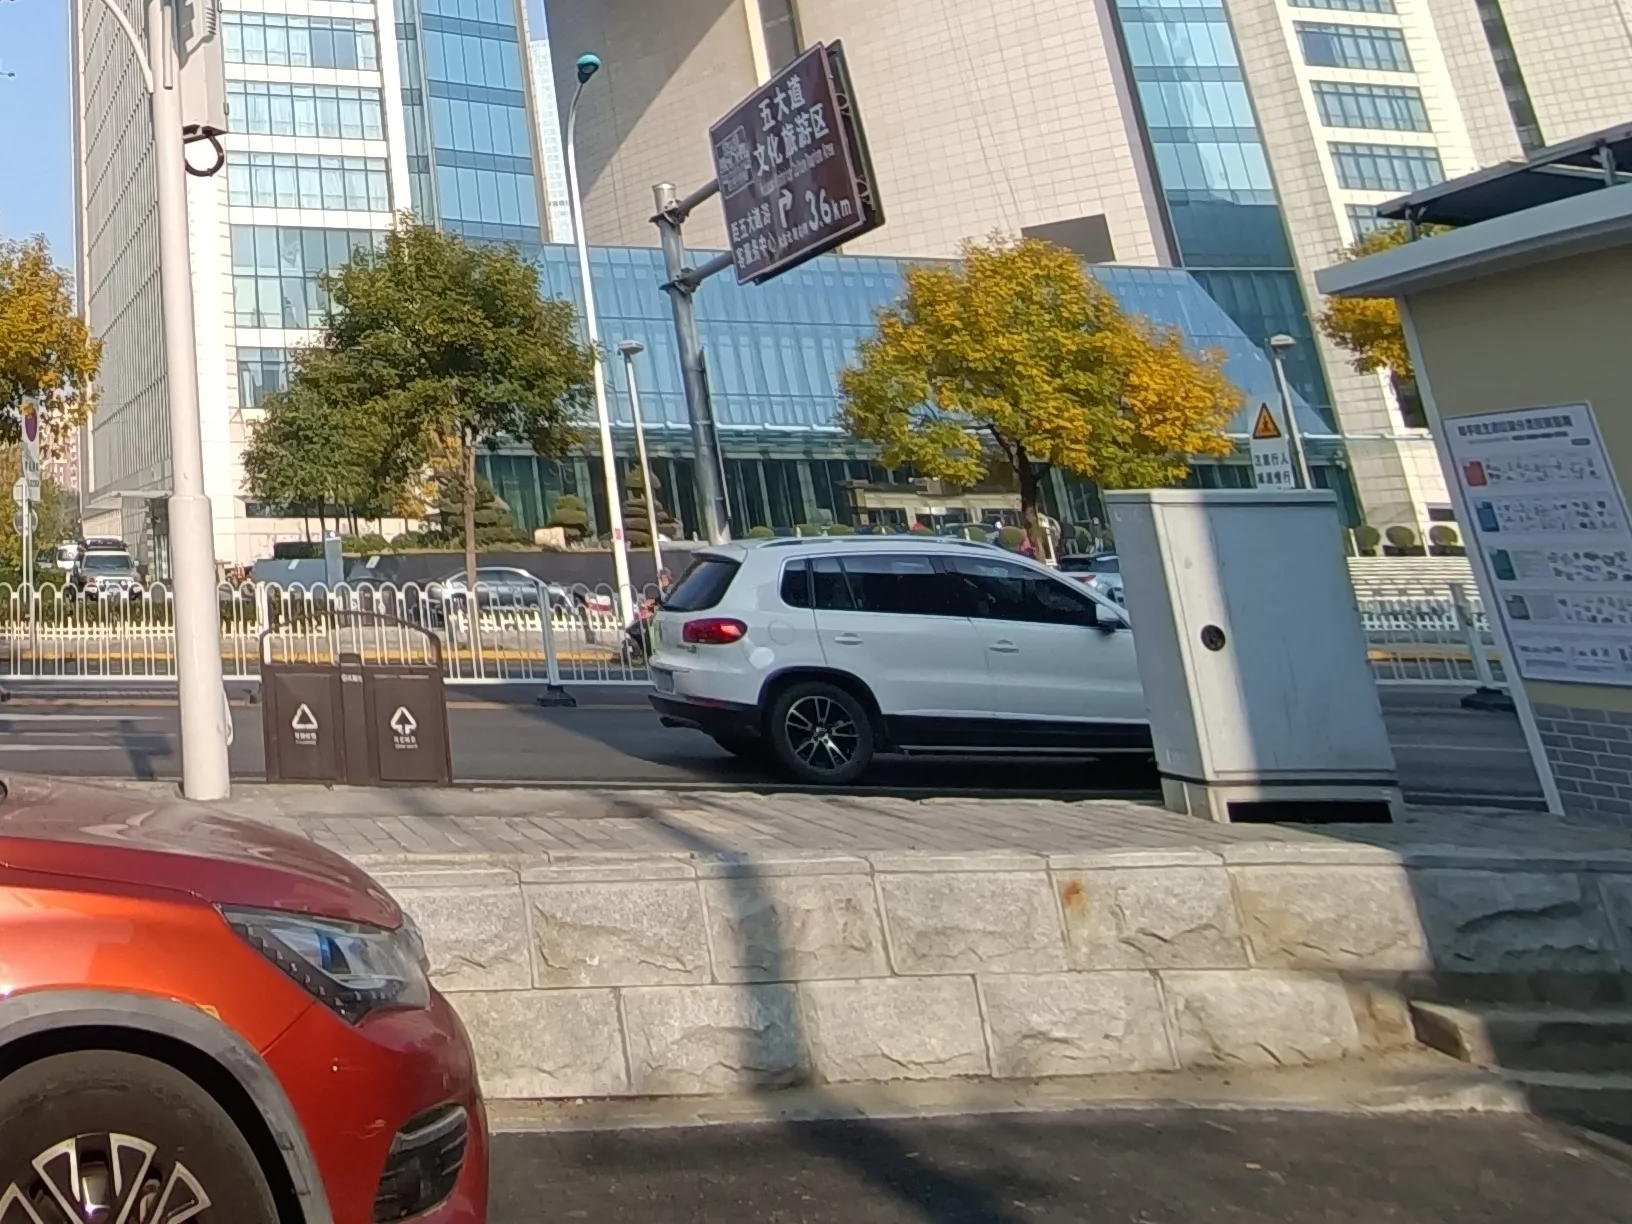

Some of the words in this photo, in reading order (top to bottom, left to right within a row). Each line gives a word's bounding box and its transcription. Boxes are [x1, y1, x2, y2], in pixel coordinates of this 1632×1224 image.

[758, 74, 805, 131] 五大道
[753, 102, 829, 176] 文化旅游区
